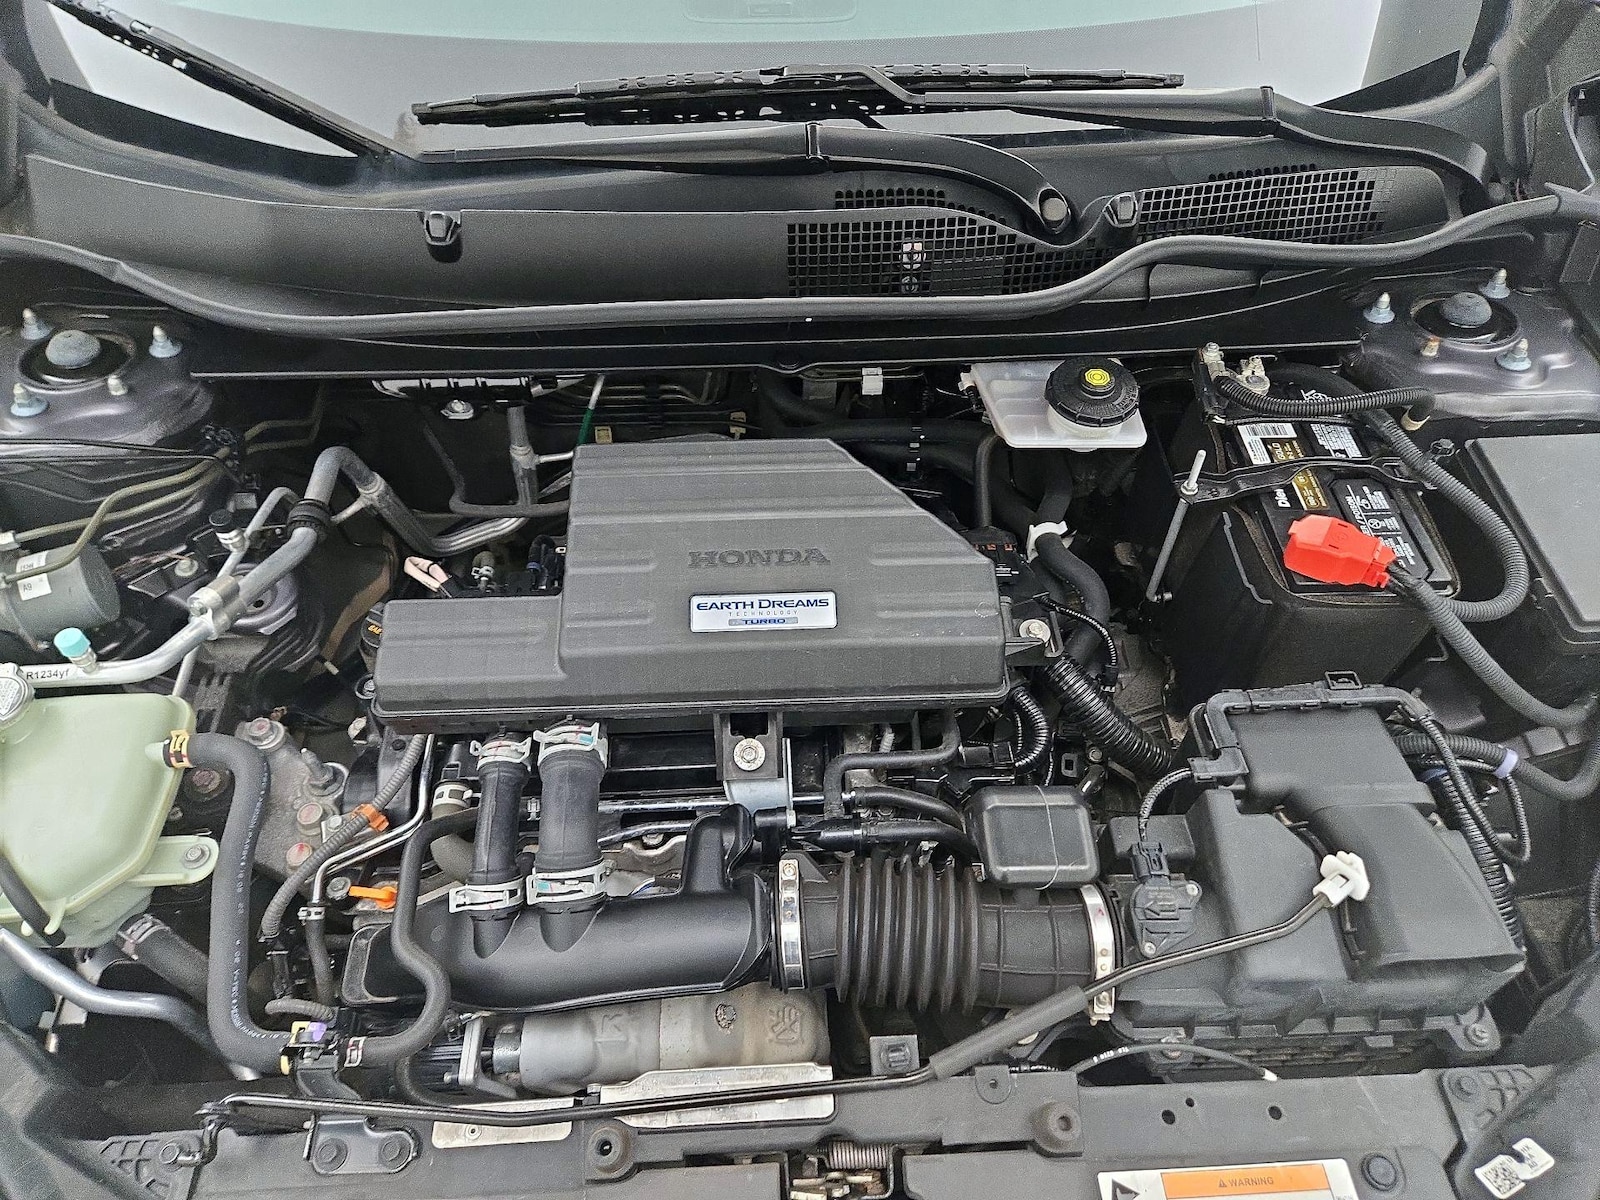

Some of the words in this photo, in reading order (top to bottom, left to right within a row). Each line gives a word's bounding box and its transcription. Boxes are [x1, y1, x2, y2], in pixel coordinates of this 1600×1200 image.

[1345, 496, 1363, 519] POISON
[688, 548, 831, 569] HONDA
[696, 601, 754, 611] EARTH
[758, 598, 829, 609] DREAMS
[729, 609, 799, 617] TECHNOLOGY
[742, 617, 786, 625] TURBO
[26, 668, 70, 680] R1234yf
[1228, 1176, 1274, 1187] WARNING
